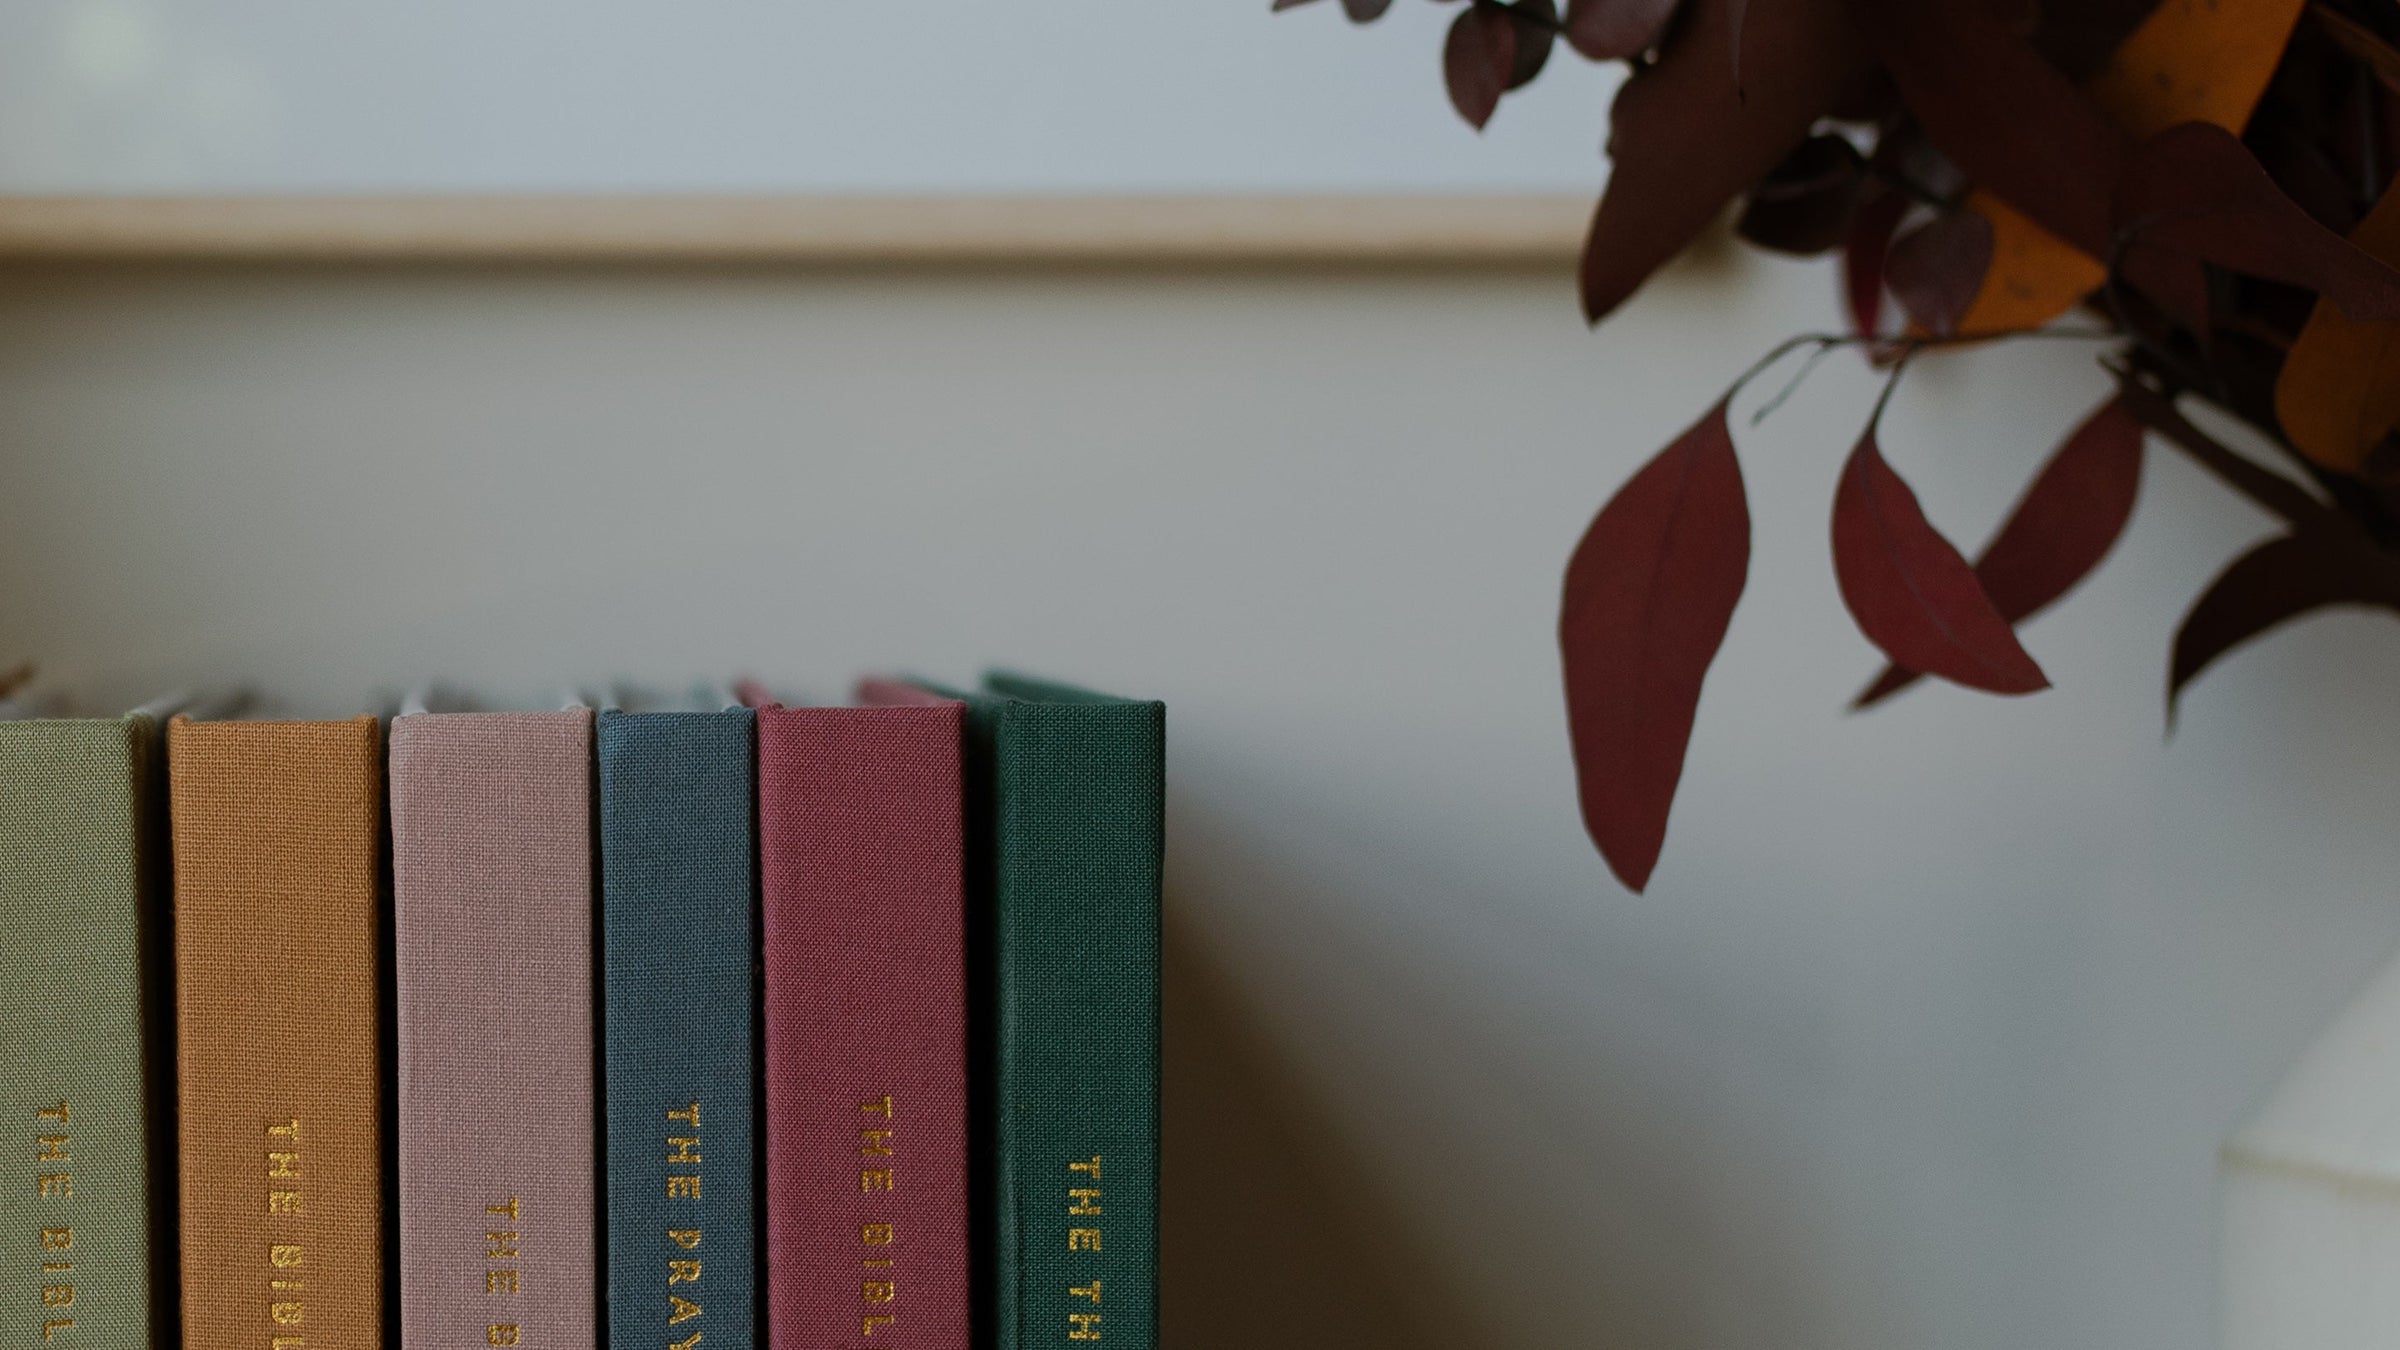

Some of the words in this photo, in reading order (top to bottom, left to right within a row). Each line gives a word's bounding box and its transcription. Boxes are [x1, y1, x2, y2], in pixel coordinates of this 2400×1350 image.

[37, 1101, 72, 1197] THE
[267, 1119, 300, 1214] THE
[667, 1102, 701, 1199] THE
[860, 1096, 892, 1192] THE
[486, 1197, 519, 1293] THE
[1069, 1155, 1100, 1250] THE
[41, 1228, 74, 1340] BIBL
[271, 1245, 303, 1350] BIBL
[1069, 1280, 1101, 1340] TH
